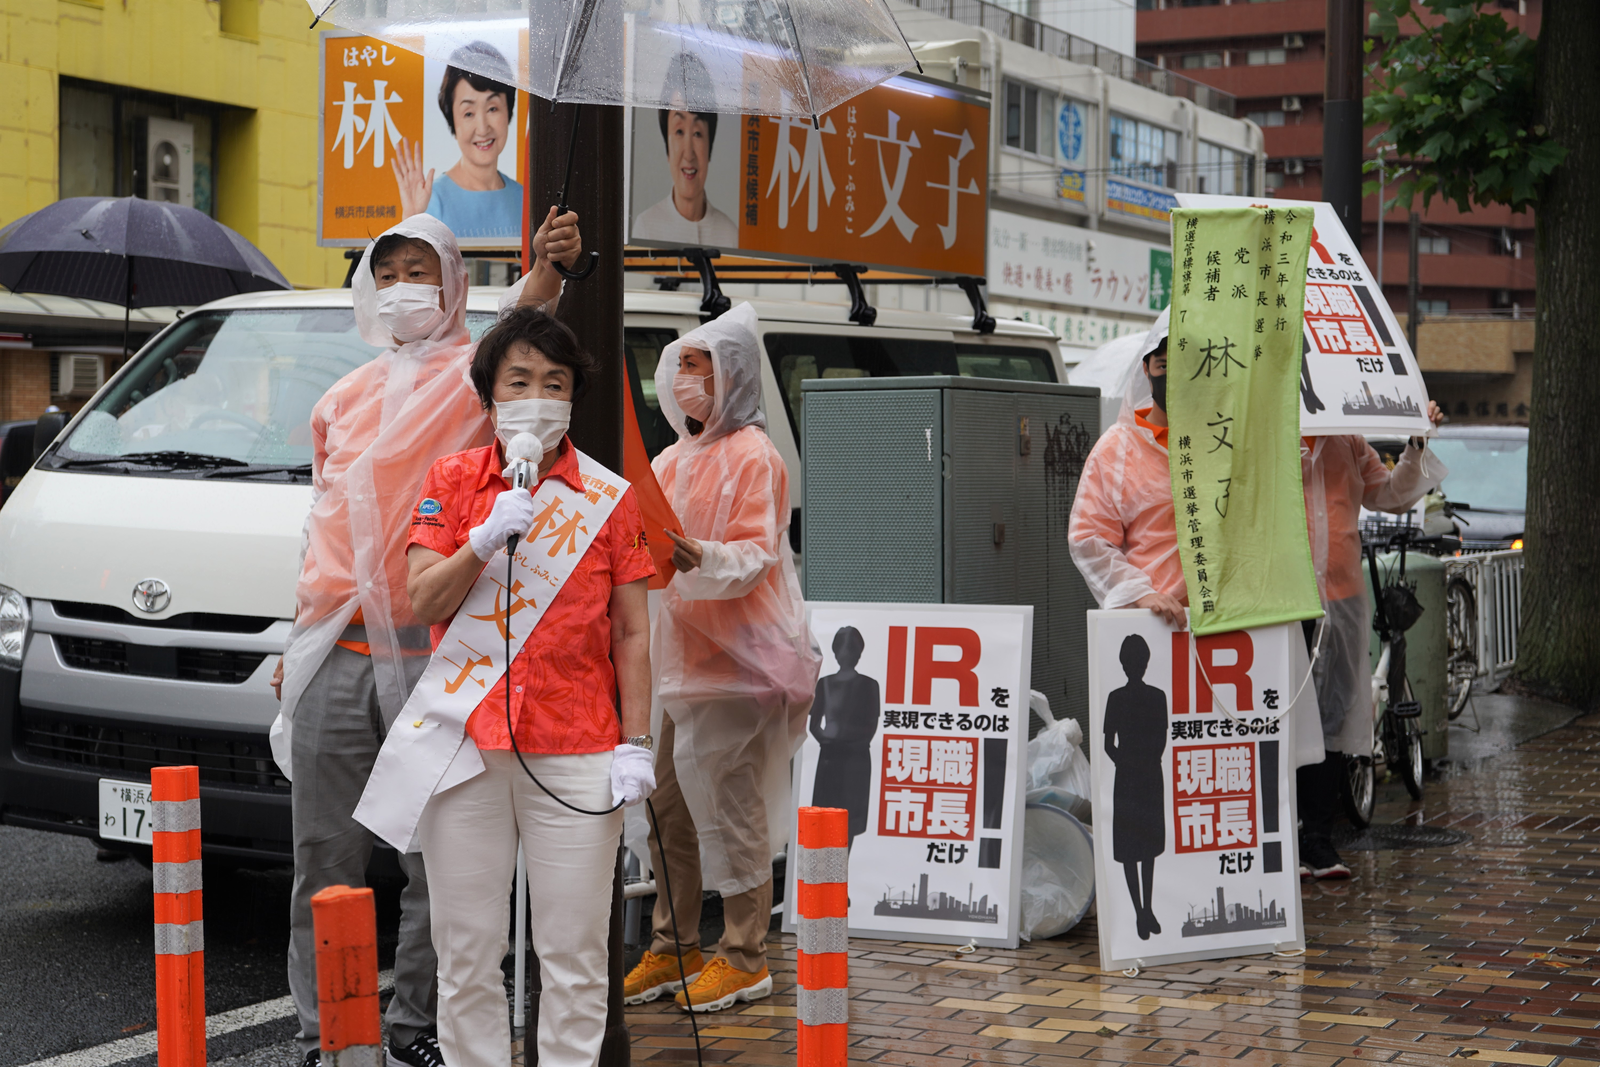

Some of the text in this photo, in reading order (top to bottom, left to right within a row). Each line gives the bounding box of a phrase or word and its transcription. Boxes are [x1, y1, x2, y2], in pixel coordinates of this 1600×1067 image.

[343, 44, 396, 68] はやし
[331, 79, 404, 170] 林
[744, 82, 762, 226] 浜市長候補
[334, 205, 397, 219] 横浜市長候補
[1203, 250, 1223, 302] 候補者
[1231, 247, 1250, 300] 党派
[1275, 210, 1298, 332] 令和三年執行
[1338, 252, 1354, 265] を
[1091, 268, 1150, 305] ラウンジ
[1311, 320, 1382, 354] 市長
[1357, 357, 1384, 374] だけ
[1178, 435, 1213, 599] 横浜市選挙管理委員会
[885, 626, 1010, 708] IR を
[1171, 630, 1279, 714] IR を
[883, 710, 1010, 732] 実現できるのは
[1171, 717, 1280, 741] 実現できるのは
[886, 738, 974, 786] 現職
[1176, 746, 1253, 796] 現職
[104, 812, 116, 827] わ
[884, 789, 970, 838] 市長
[1177, 800, 1254, 849] 市長
[926, 842, 969, 864] だけ
[1219, 852, 1254, 875] だけ
